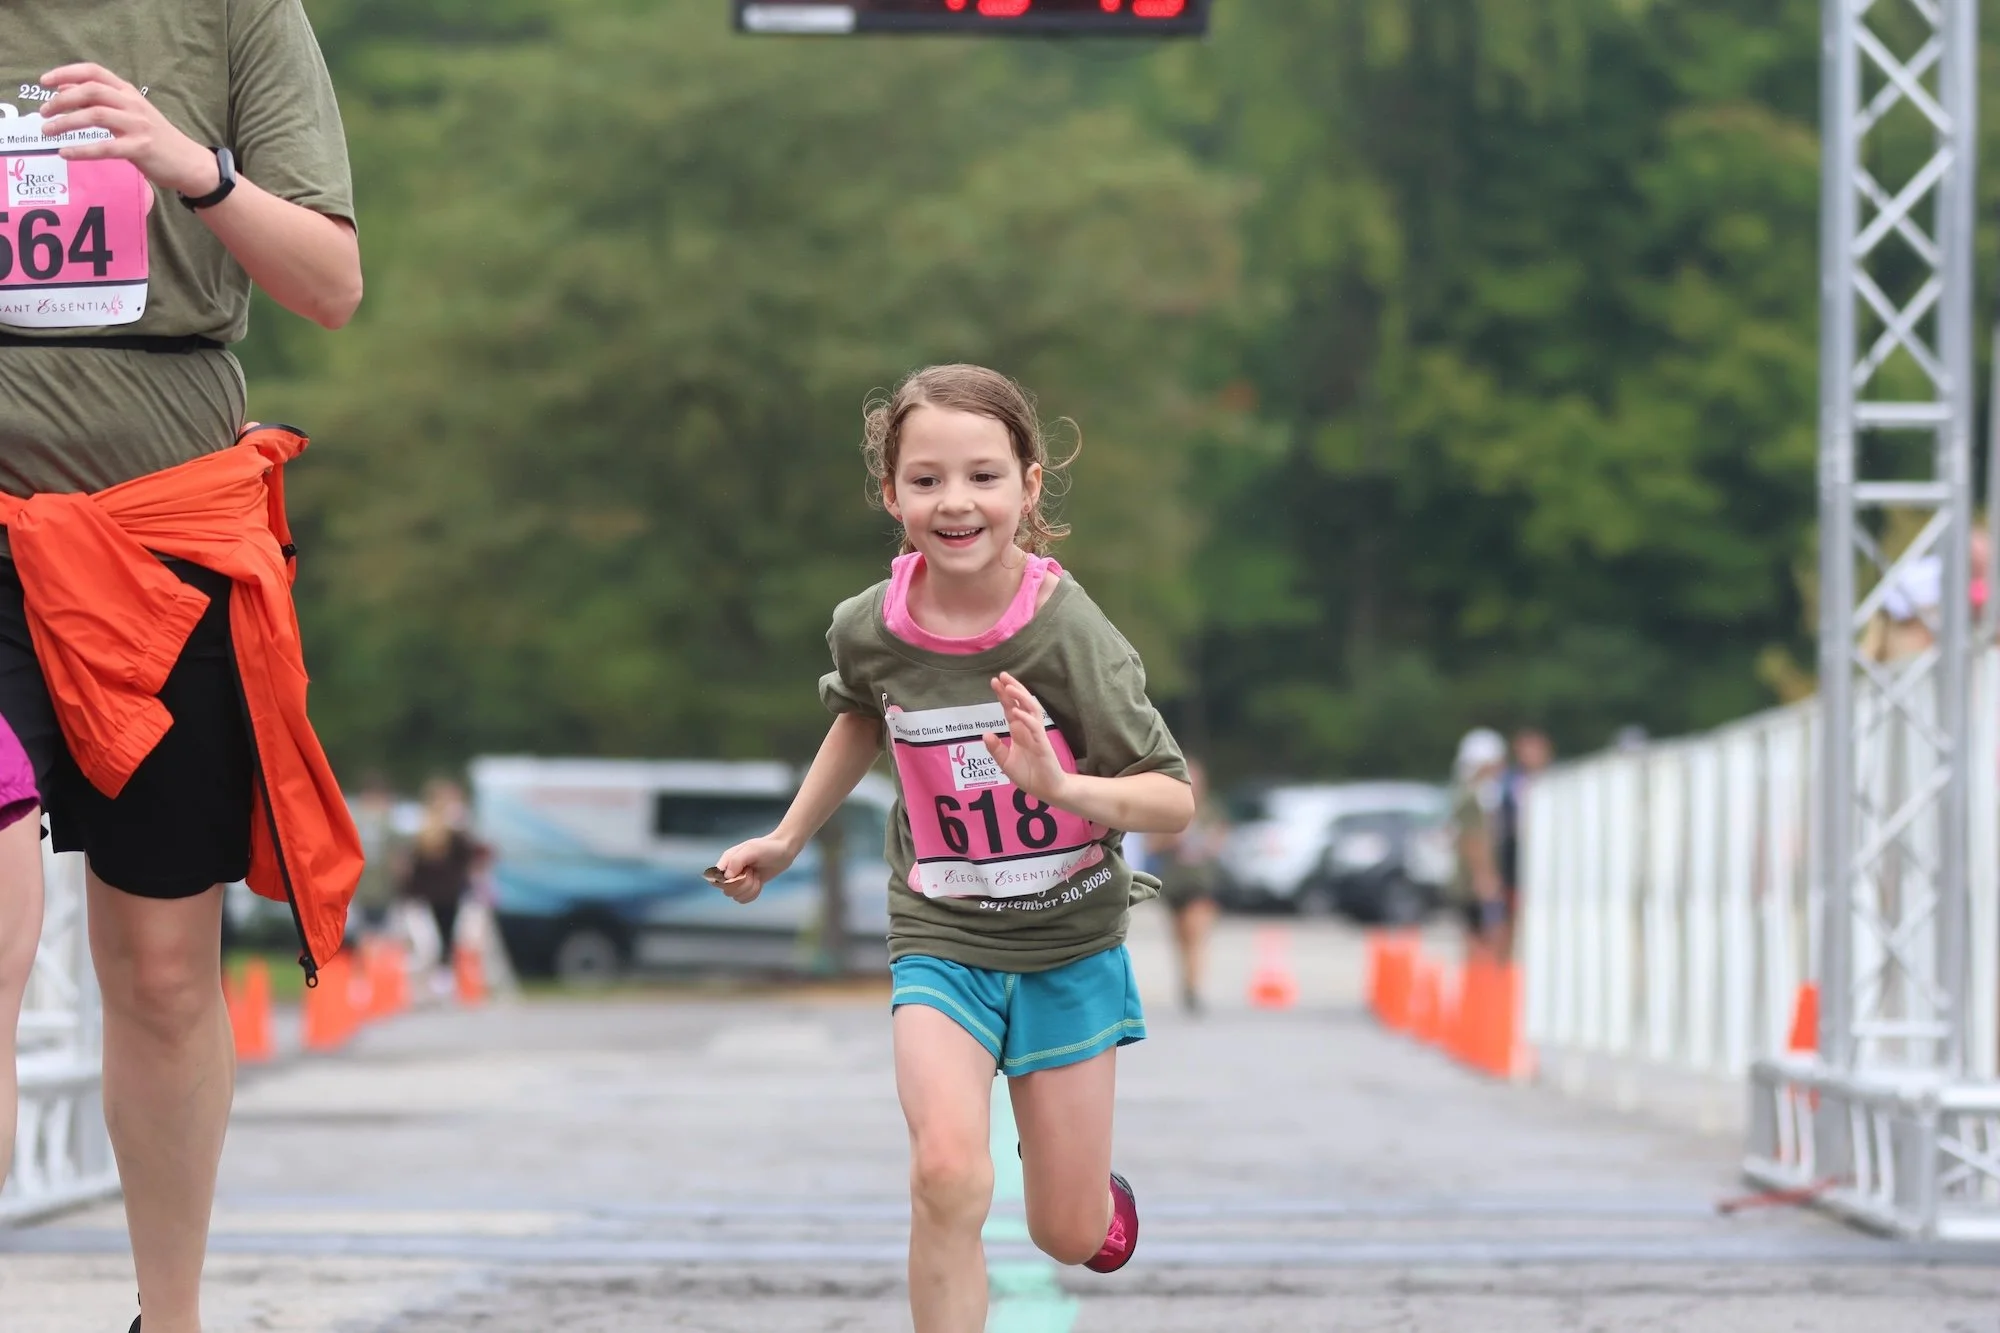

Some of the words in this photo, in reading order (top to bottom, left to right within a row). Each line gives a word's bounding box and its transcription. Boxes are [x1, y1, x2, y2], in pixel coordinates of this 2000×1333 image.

[7, 133, 39, 144] Medina
[41, 132, 76, 144] Hospital
[78, 131, 112, 140] Medical
[25, 174, 54, 186] Race
[17, 182, 56, 195] Grace
[0, 304, 30, 313] ANT
[37, 298, 124, 314] ESSENTIALS
[895, 725, 920, 736] Cland
[921, 726, 944, 736] Clinic
[945, 723, 974, 733] Medina
[975, 719, 1006, 730] Hospital
[967, 757, 994, 770] Race
[960, 767, 997, 779] Grace
[934, 788, 1058, 855] 618
[979, 898, 1059, 911] September
[1061, 887, 1082, 904] 20,
[1082, 867, 1112, 893] 2026
